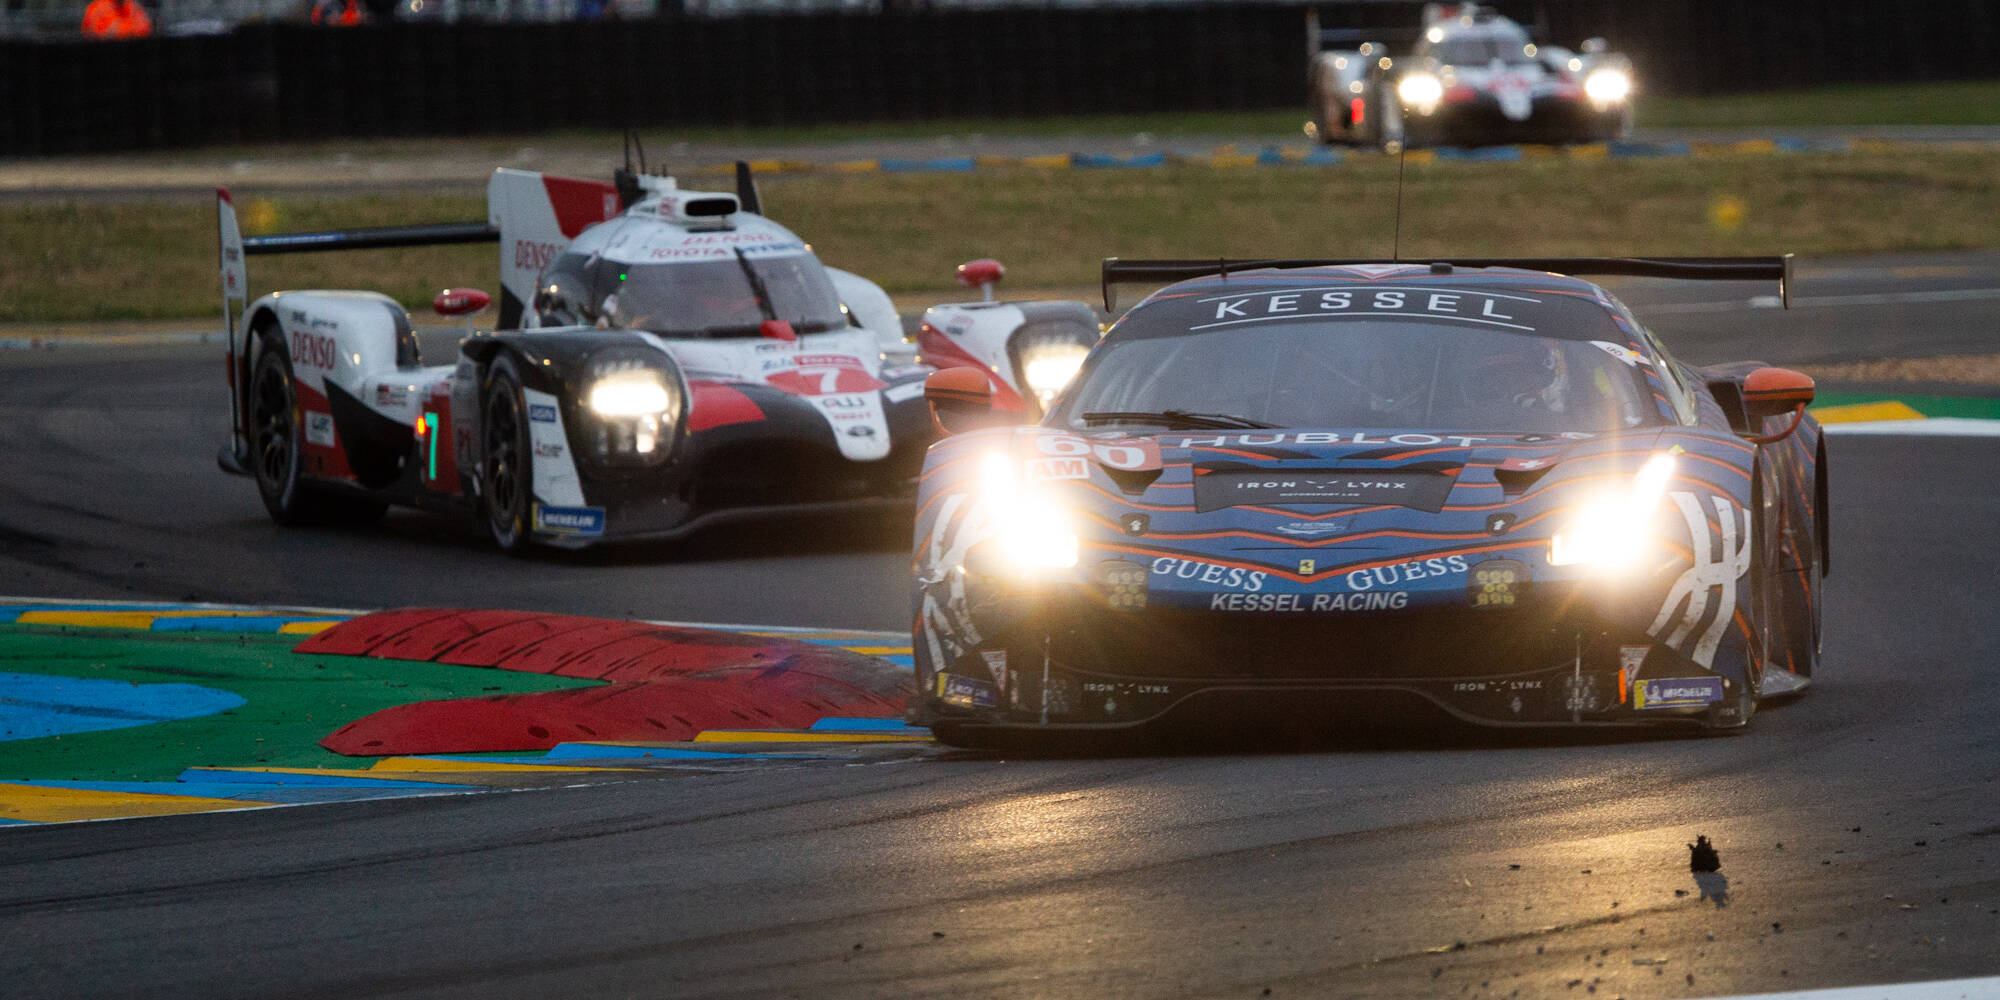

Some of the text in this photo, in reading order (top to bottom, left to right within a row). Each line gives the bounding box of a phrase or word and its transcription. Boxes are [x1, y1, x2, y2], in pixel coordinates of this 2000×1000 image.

[651, 247, 728, 259] TOYOTA
[1215, 292, 1513, 319] KESSEL
[292, 331, 337, 370] DENSO
[798, 368, 840, 393] 7
[424, 412, 439, 479] 7
[1179, 432, 1488, 448] HUBLOT
[1037, 435, 1146, 469] 60
[1031, 459, 1085, 478] AM
[1237, 481, 1407, 489] IRON LYNX
[1152, 557, 1267, 592] GUESS
[1346, 554, 1468, 591] GUESS
[1210, 591, 1409, 612] KESSEL RACING
[1084, 682, 1170, 694] IRON LYNX
[1454, 681, 1543, 691] IRON LYNX
[1663, 687, 1713, 698] MICHELIN
